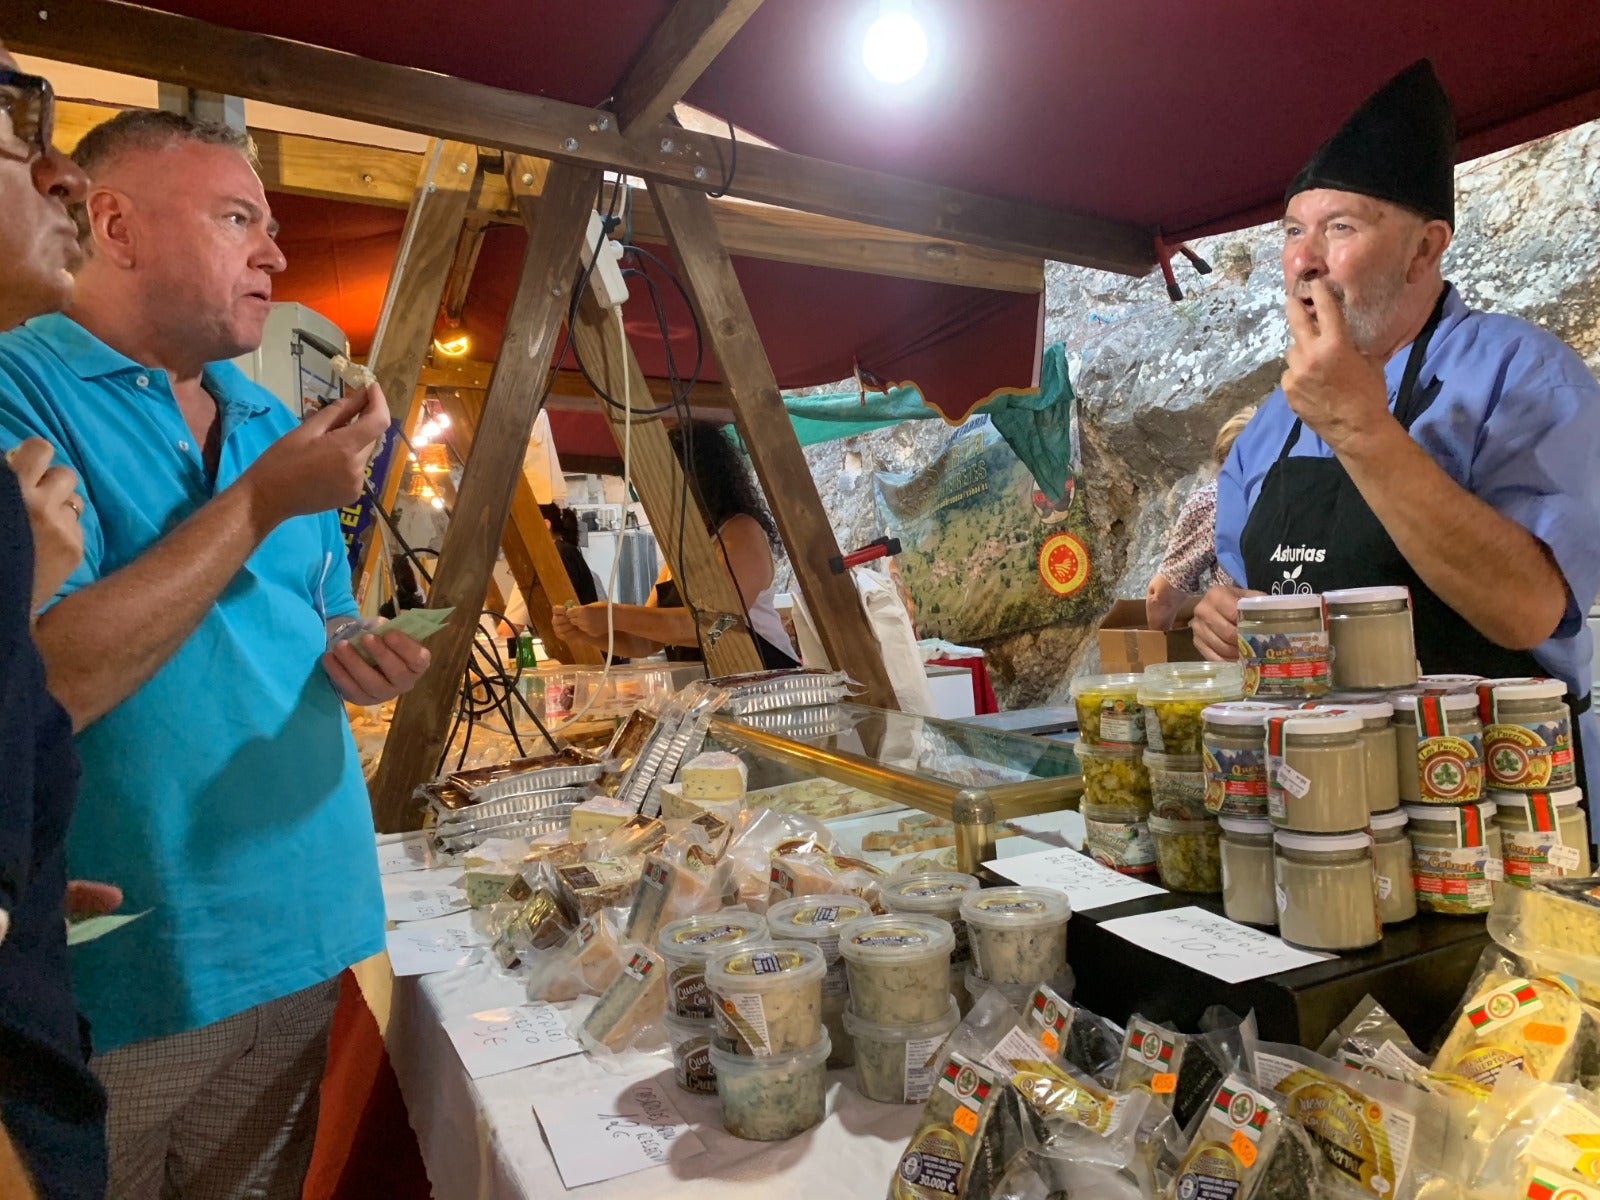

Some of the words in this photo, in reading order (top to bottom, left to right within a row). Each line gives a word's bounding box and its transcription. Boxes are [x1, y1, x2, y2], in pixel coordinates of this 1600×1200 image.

[341, 504, 362, 527] EL
[1270, 544, 1326, 563] Asturias
[1266, 648, 1298, 660] Queso
[1437, 743, 1469, 758] Puertos
[677, 982, 706, 1000] Queso
[688, 1055, 709, 1071] Que
[920, 1174, 947, 1189] 30.000
